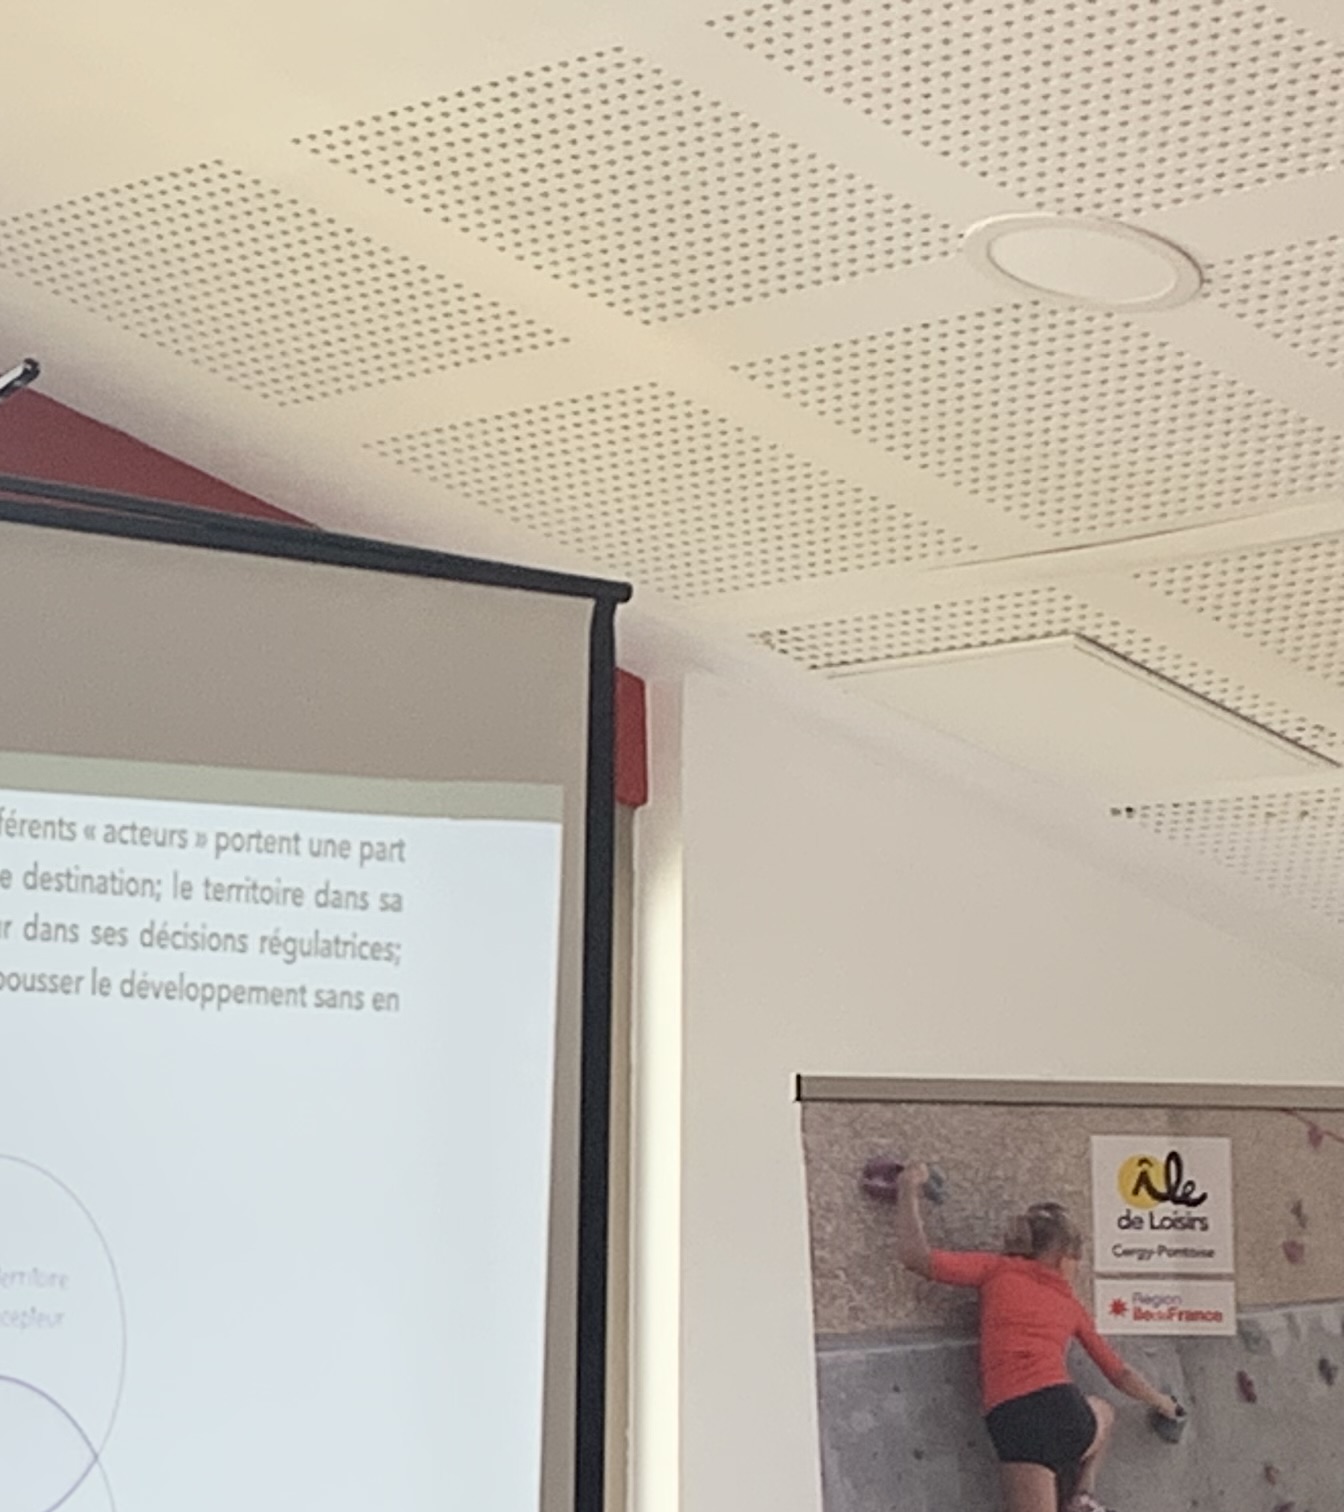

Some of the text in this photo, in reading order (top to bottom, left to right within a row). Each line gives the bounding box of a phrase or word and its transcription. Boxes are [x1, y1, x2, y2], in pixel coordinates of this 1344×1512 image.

[103, 821, 188, 849] acteurs
[215, 829, 301, 860] portent
[308, 836, 352, 860] une
[360, 838, 406, 869] part
[22, 861, 162, 902] destination;
[173, 870, 193, 901] le
[203, 875, 305, 907] territoire
[315, 880, 369, 911] dans
[379, 890, 404, 913] sa
[23, 912, 79, 944] dans
[90, 923, 128, 947] ses
[139, 919, 249, 954] décisions
[259, 927, 402, 966] régulatrices;
[91, 966, 112, 997] le
[119, 969, 307, 1012] développement
[313, 987, 365, 1012] sans
[372, 991, 400, 1012] en
[1117, 1209, 1209, 1231] de Loisirs
